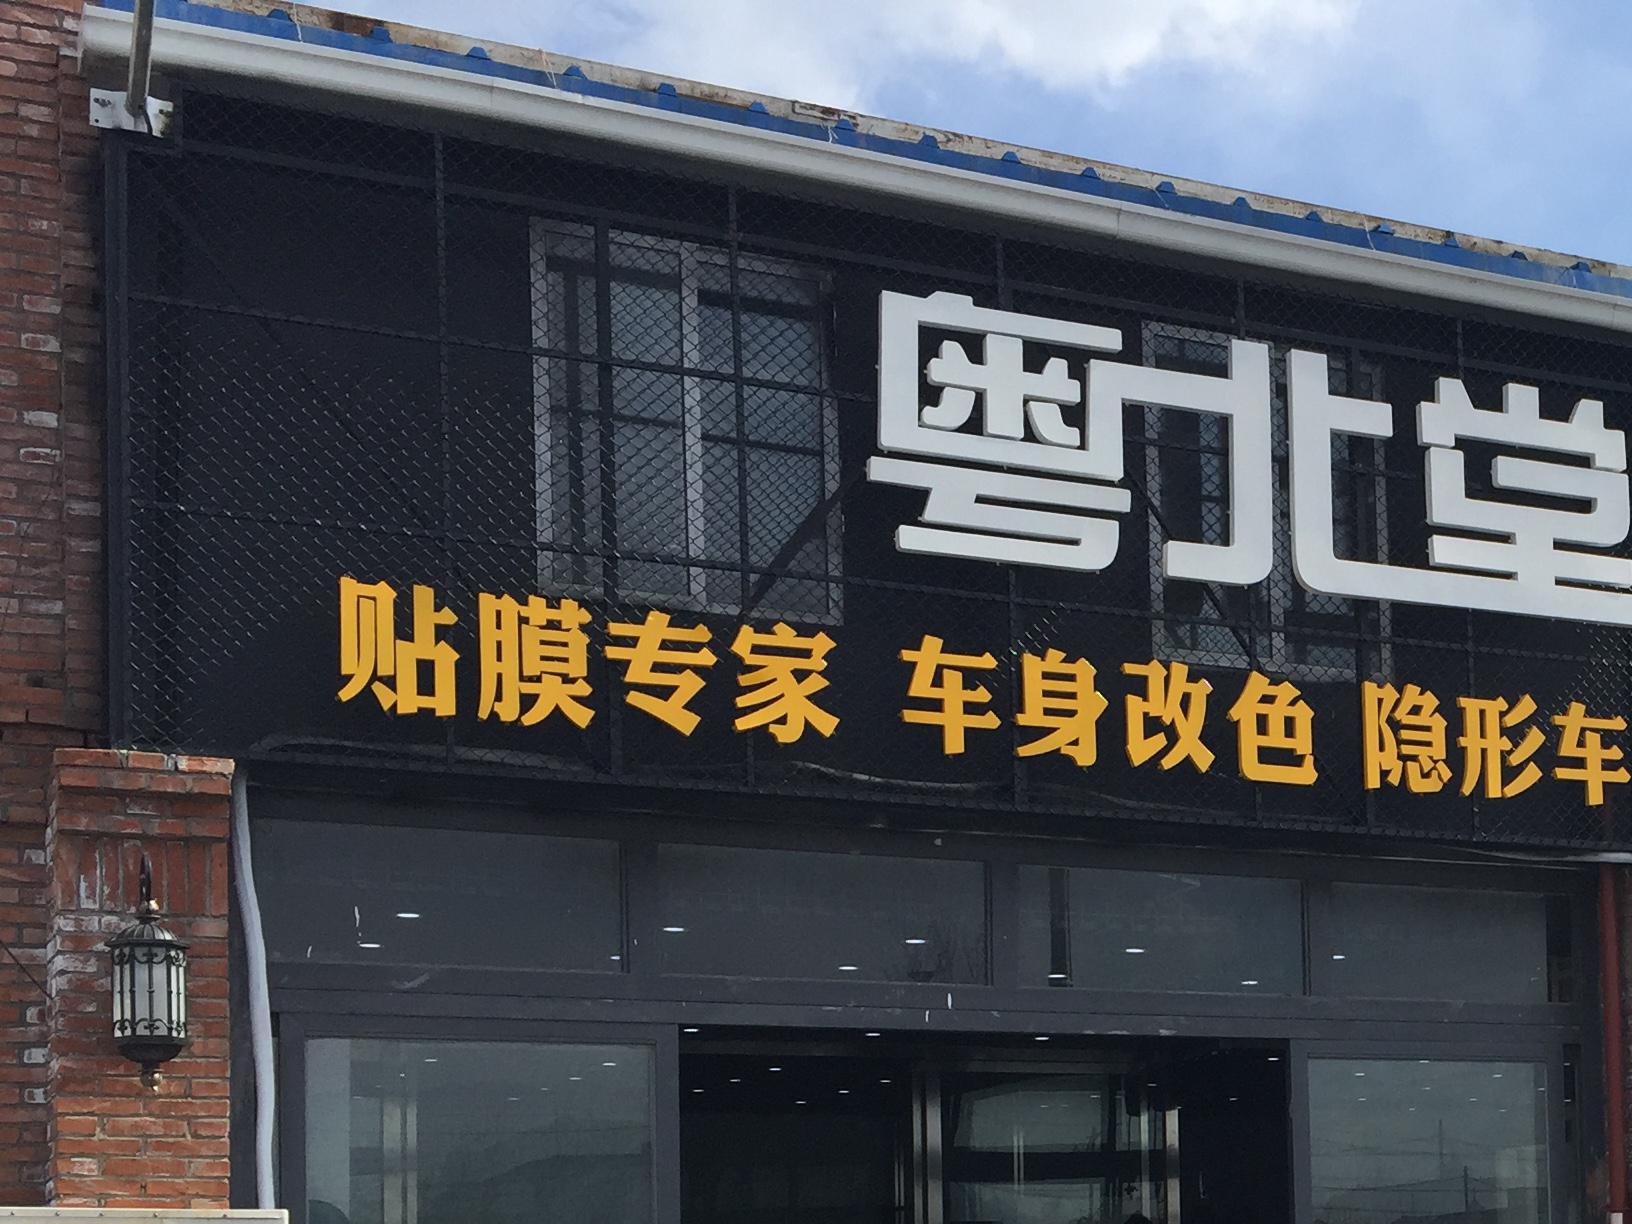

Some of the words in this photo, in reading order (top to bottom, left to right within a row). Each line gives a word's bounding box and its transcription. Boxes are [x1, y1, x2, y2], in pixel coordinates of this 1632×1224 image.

[336, 576, 842, 745] 贴膜专家
[899, 634, 1319, 787] 车身改色
